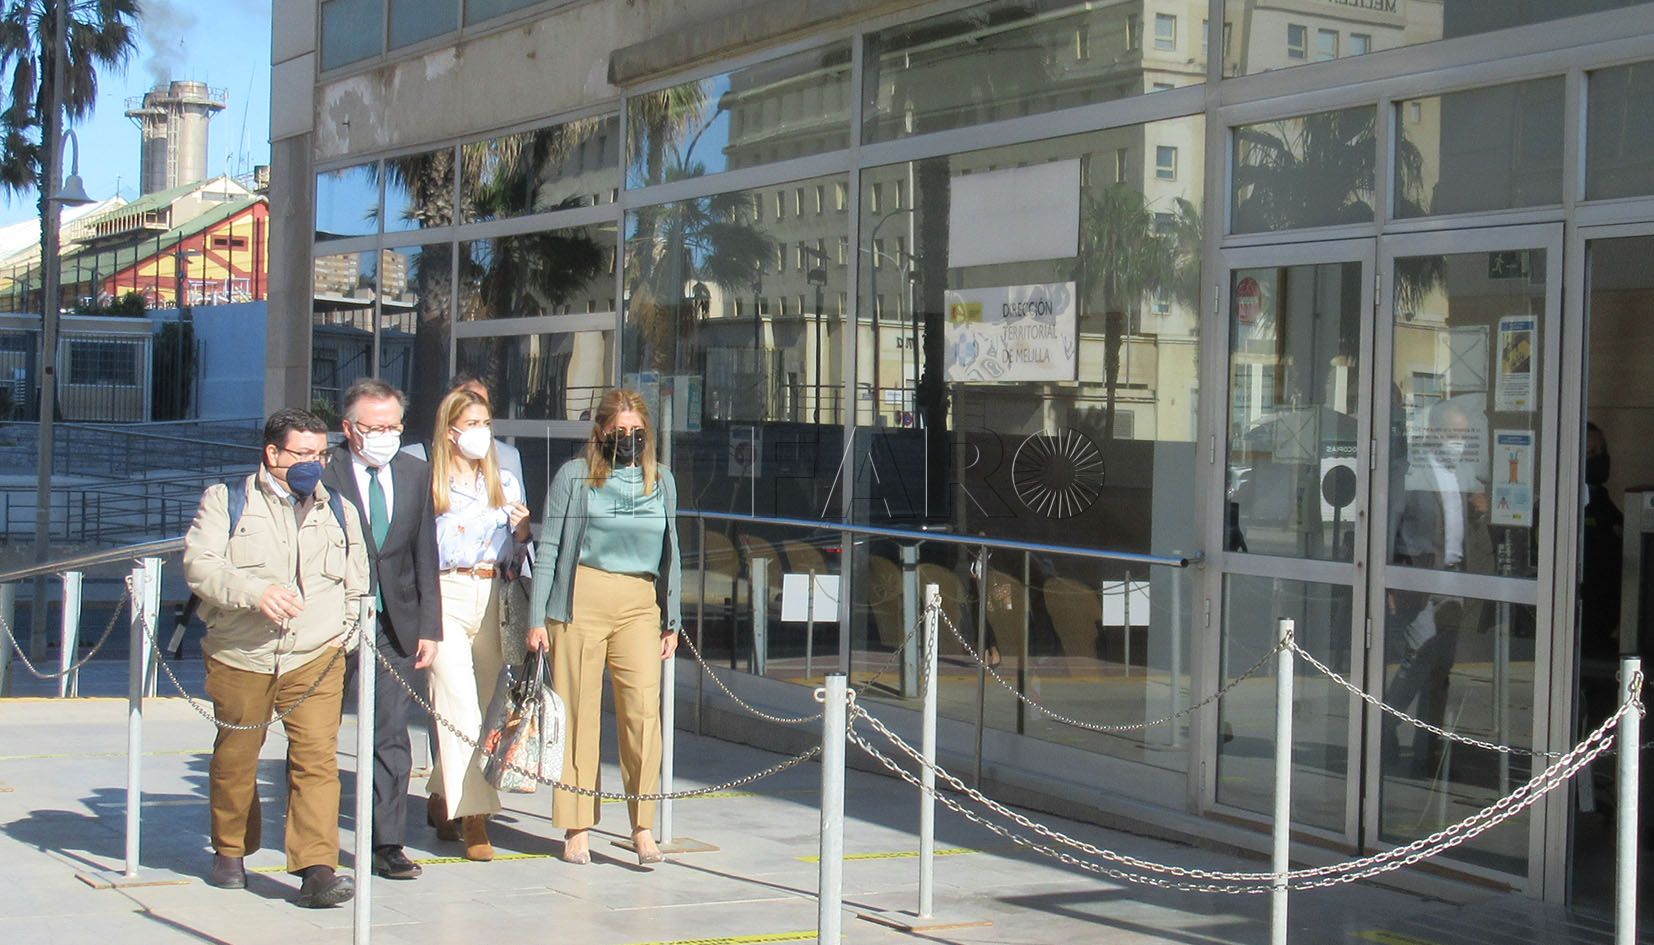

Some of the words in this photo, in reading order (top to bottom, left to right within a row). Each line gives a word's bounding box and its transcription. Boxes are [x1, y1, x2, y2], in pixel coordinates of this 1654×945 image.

[1003, 298, 1053, 317] DIRECCIÓN
[1002, 323, 1057, 340] TERRITORIAL
[1002, 349, 1013, 364] DE
[1016, 347, 1050, 363] MELILLA
